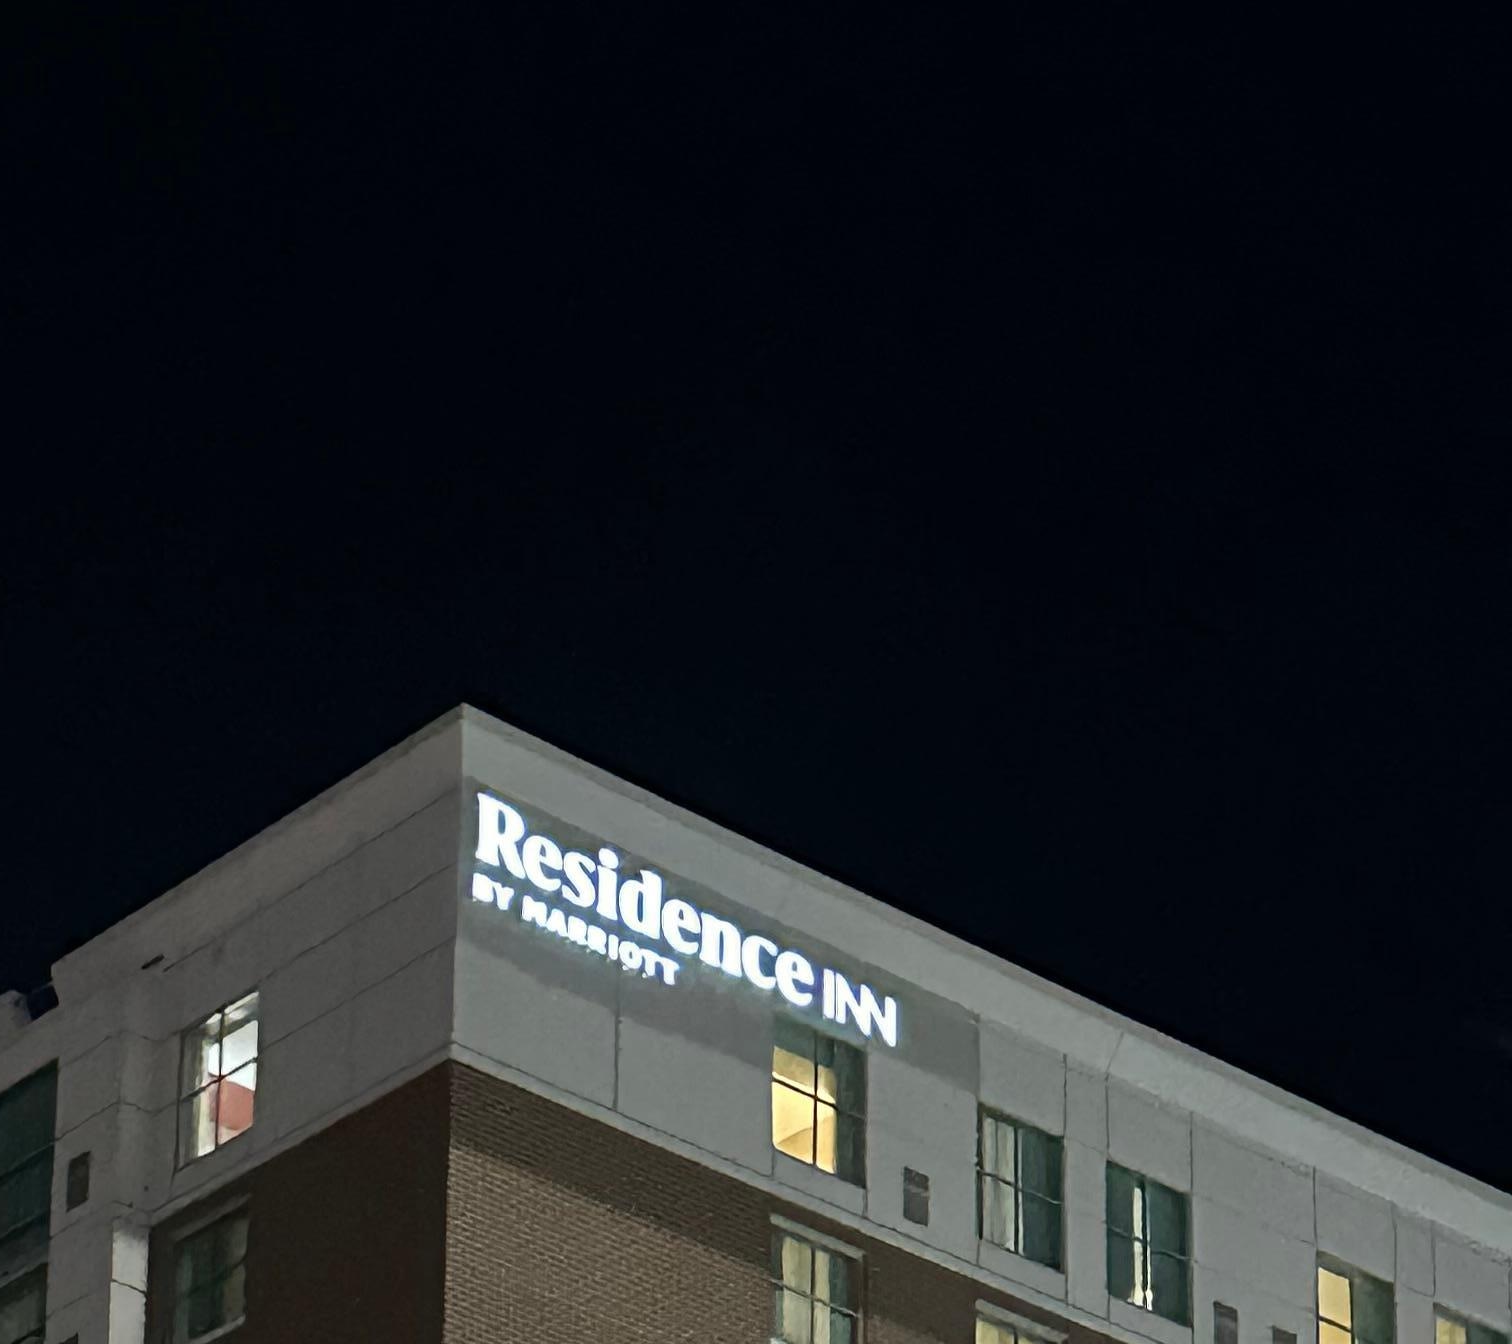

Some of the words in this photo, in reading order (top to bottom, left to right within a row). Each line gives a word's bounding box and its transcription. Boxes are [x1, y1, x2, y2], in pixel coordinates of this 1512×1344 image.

[472, 872, 516, 910] BY
[521, 895, 680, 986] MARRIOTT
[474, 792, 816, 1008] Residence
[822, 967, 898, 1048] INN
